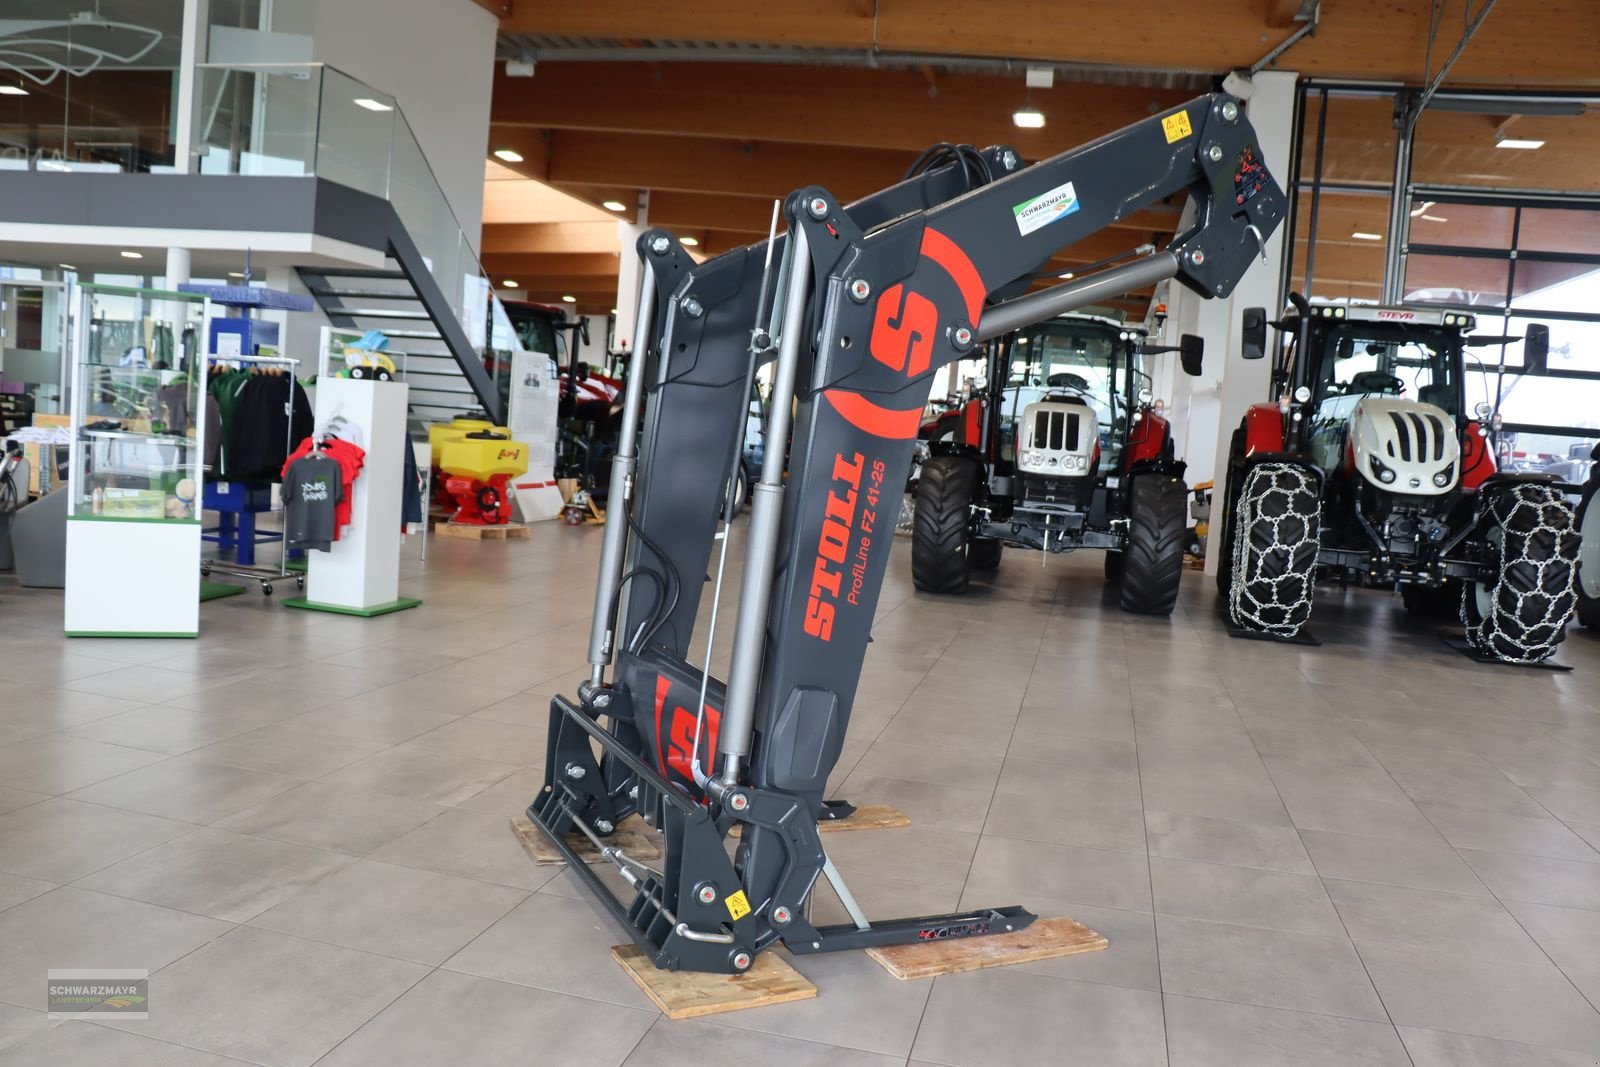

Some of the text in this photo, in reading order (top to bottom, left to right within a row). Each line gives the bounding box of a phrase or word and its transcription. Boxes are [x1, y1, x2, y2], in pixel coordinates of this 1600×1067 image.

[1021, 193, 1067, 218] SCHWARZMAYR
[1378, 311, 1414, 320] STEYR
[803, 452, 865, 642] STOLL
[847, 459, 885, 606] ProfiLine FZ 41-25
